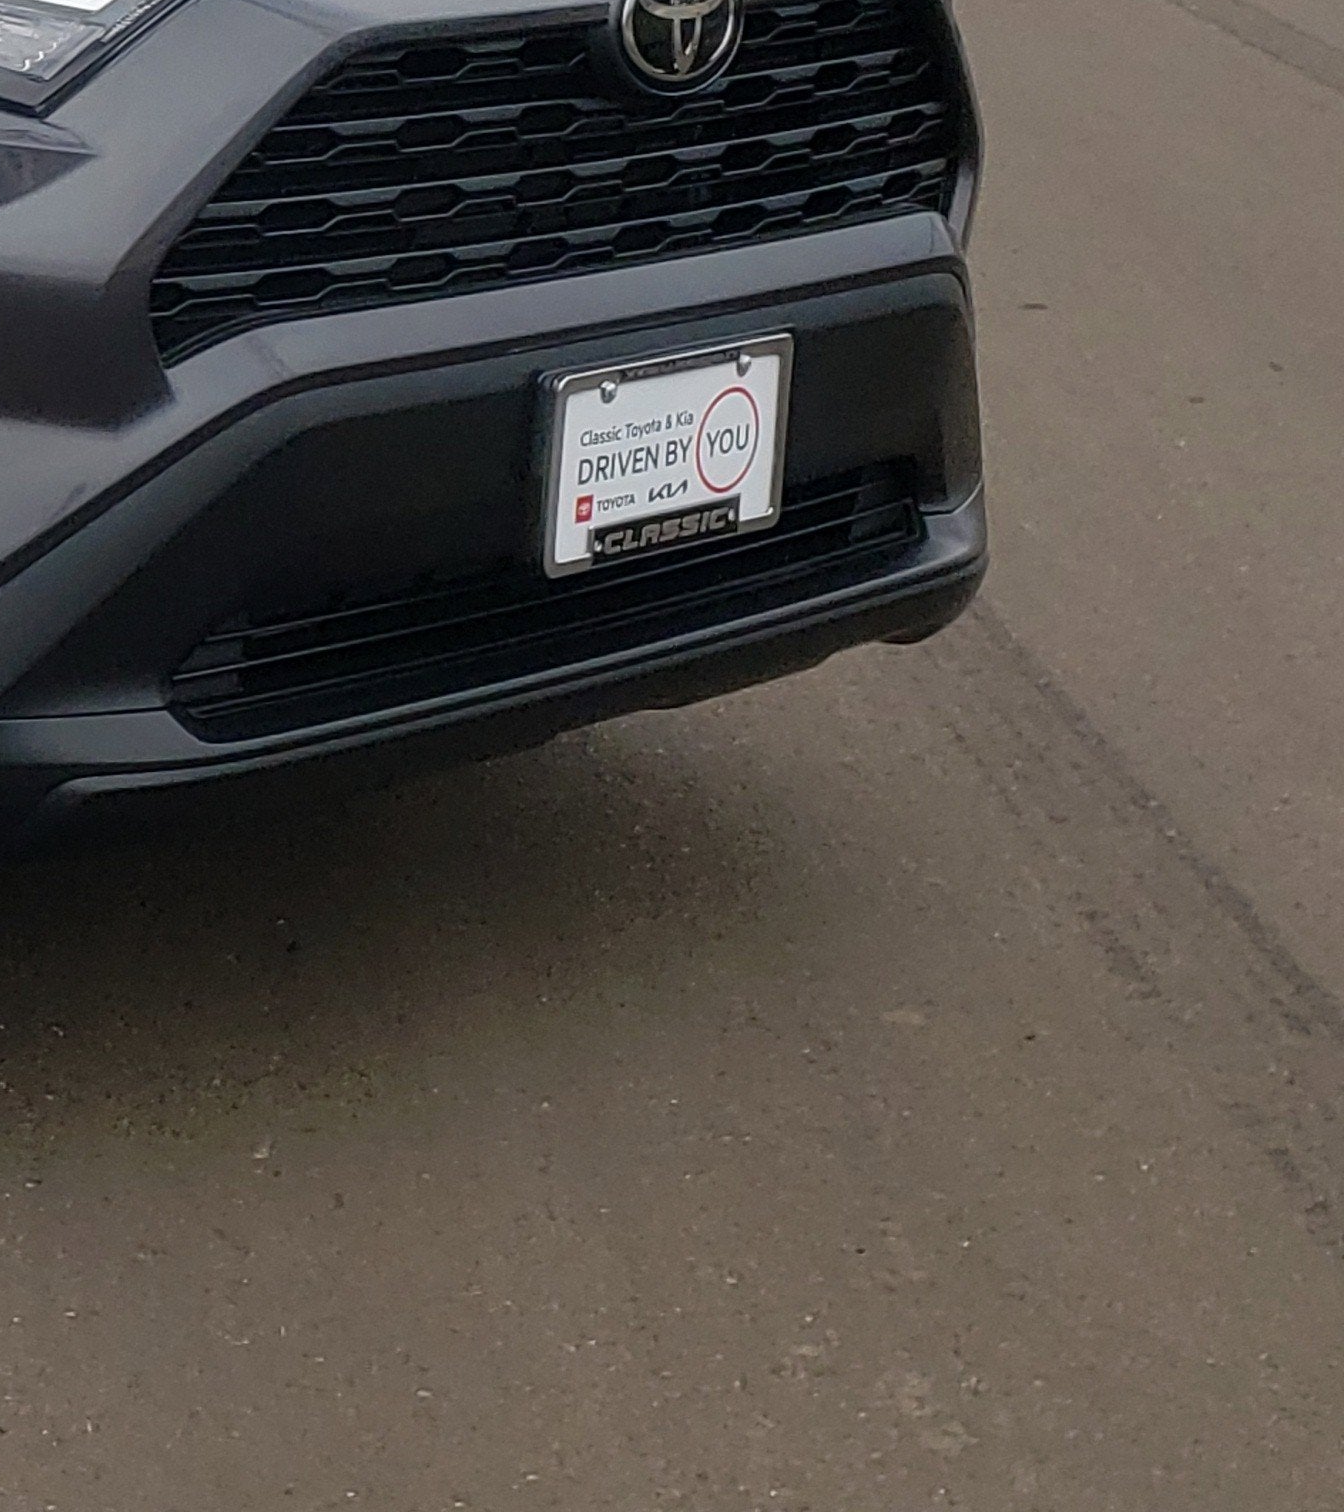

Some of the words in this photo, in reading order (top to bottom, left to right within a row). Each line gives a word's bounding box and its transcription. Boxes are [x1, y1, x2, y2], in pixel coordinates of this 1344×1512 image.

[580, 425, 622, 446] Classic
[625, 418, 662, 437] Toyota
[665, 414, 673, 429] &
[676, 410, 694, 426] Kia
[578, 444, 660, 485] DRIVEN
[665, 436, 693, 466] BY
[706, 423, 750, 458] YOU
[597, 493, 636, 513] TOYOTA
[603, 507, 729, 554] CLASSIC
